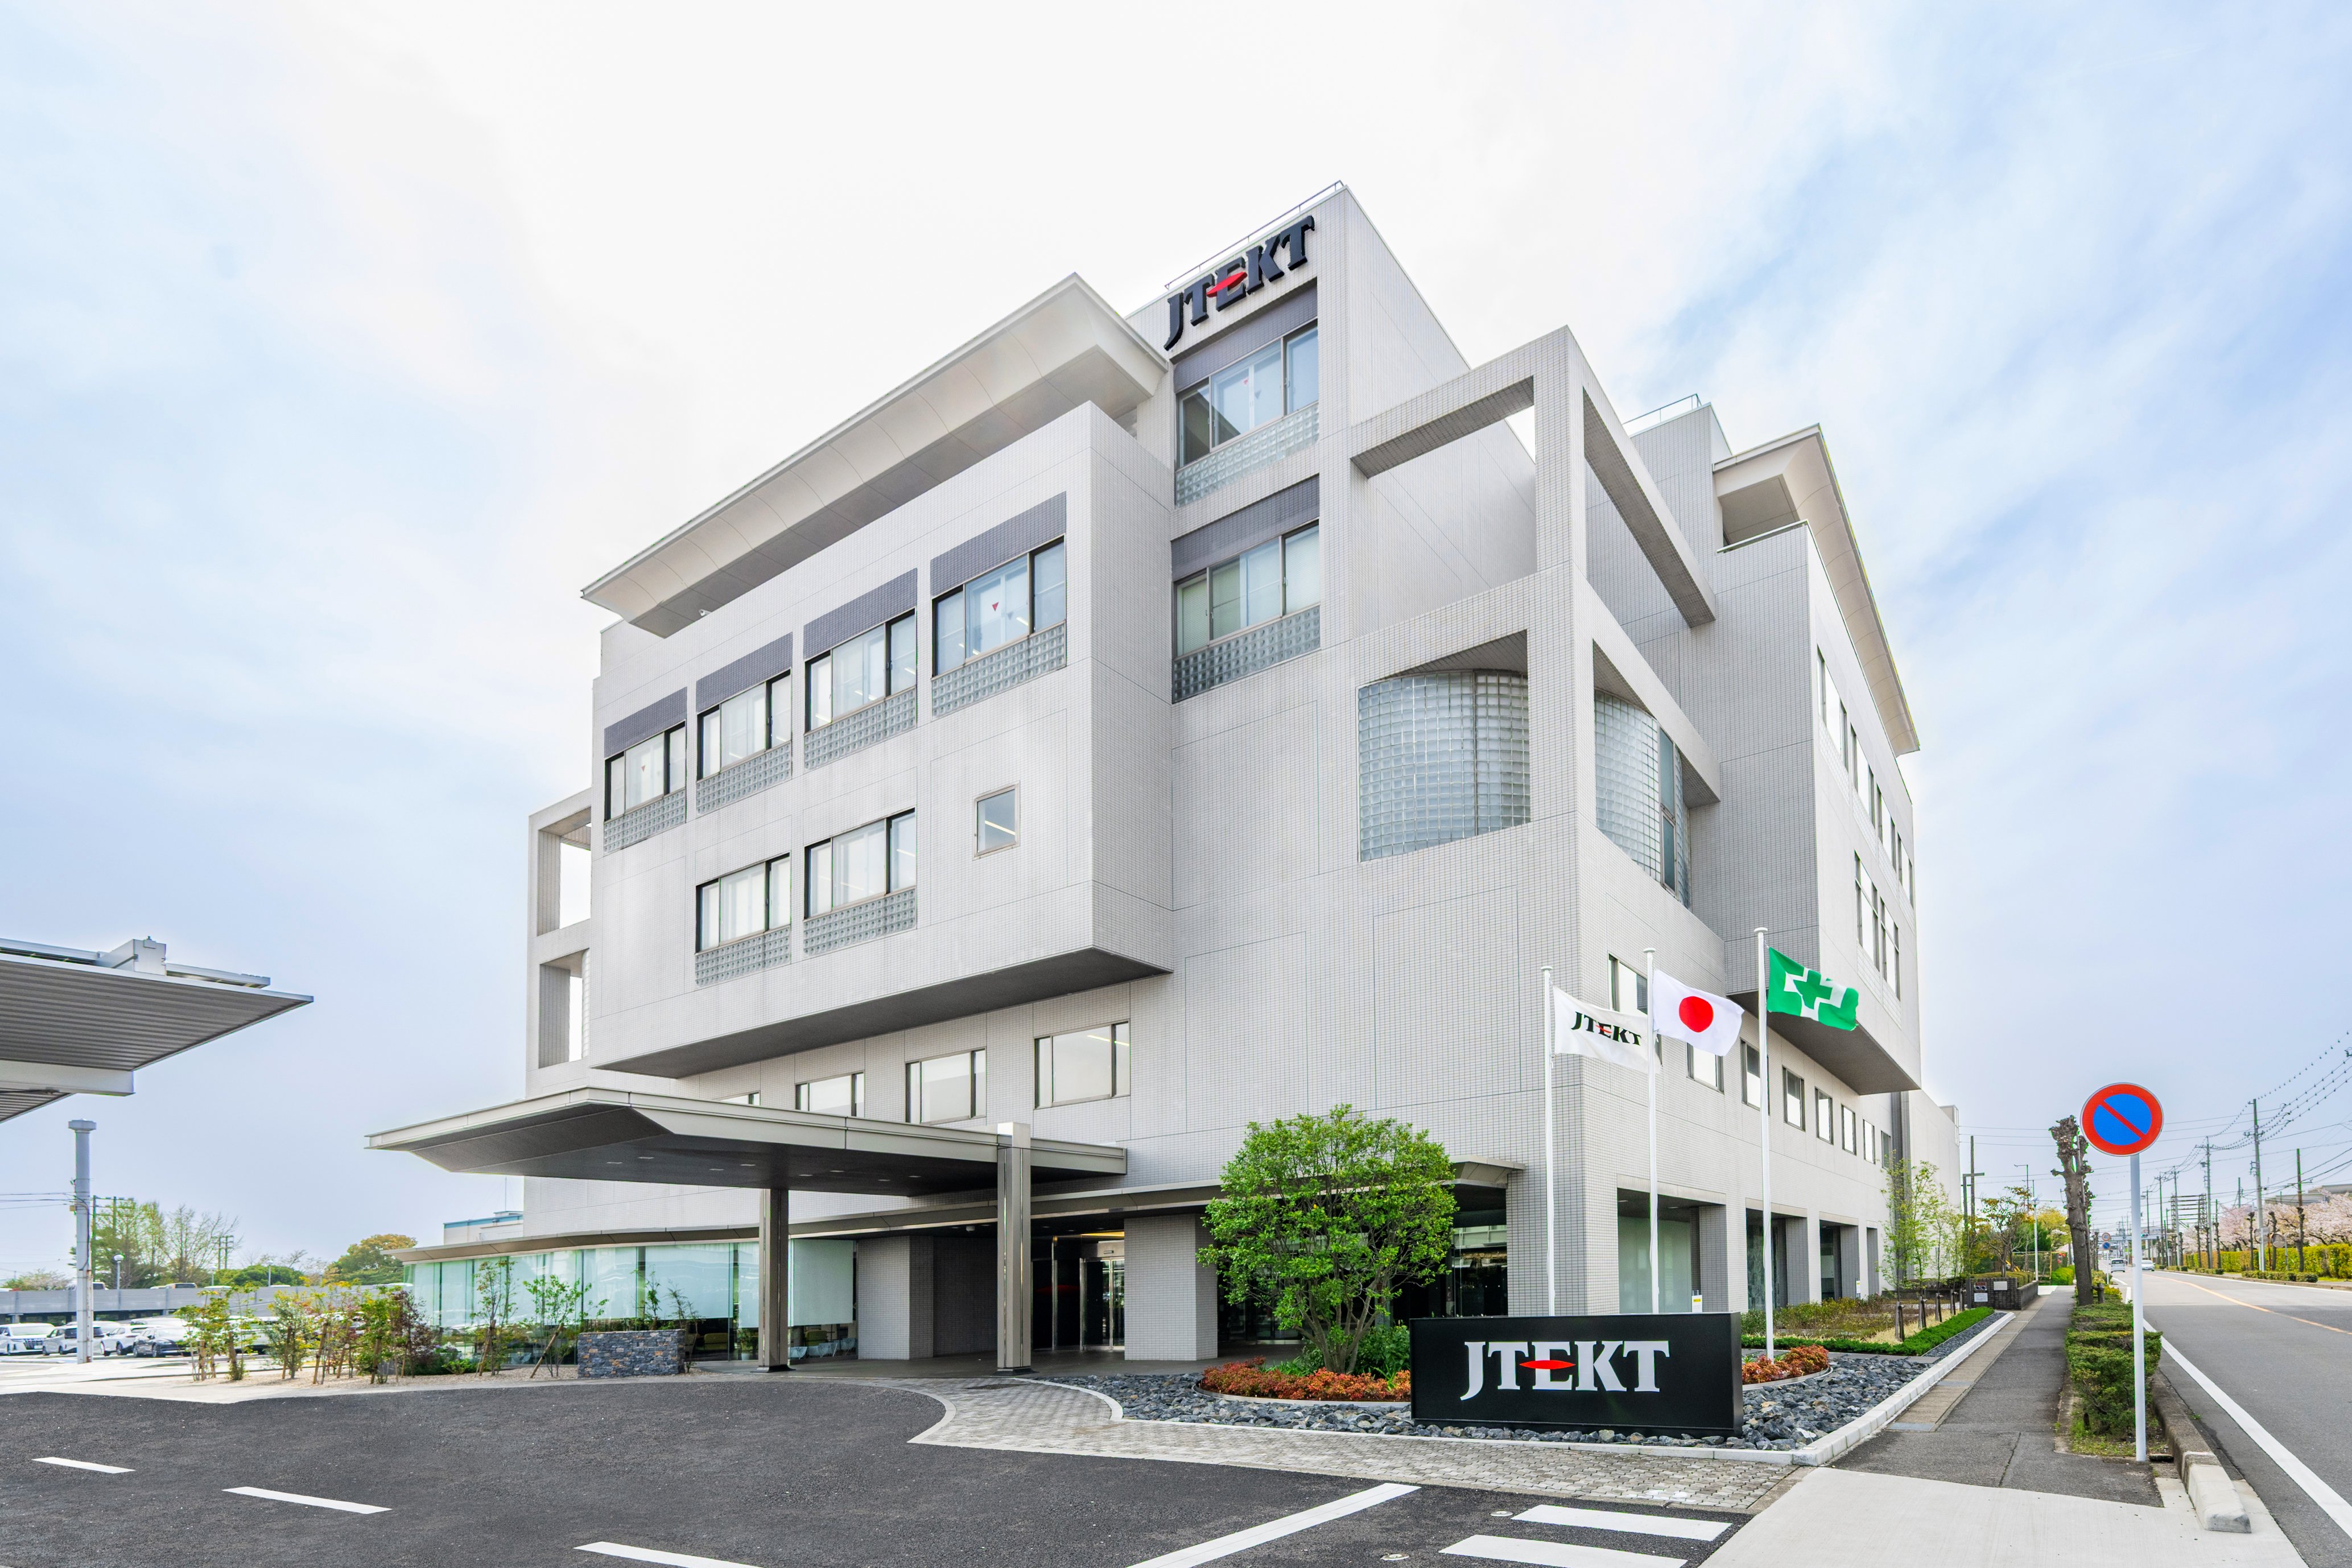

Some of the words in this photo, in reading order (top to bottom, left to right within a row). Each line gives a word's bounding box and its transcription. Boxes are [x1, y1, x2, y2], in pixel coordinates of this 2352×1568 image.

[1163, 215, 1315, 351] JTEKT
[1571, 1011, 1642, 1046] JTEKT
[1460, 1340, 1669, 1400] JTEKT
